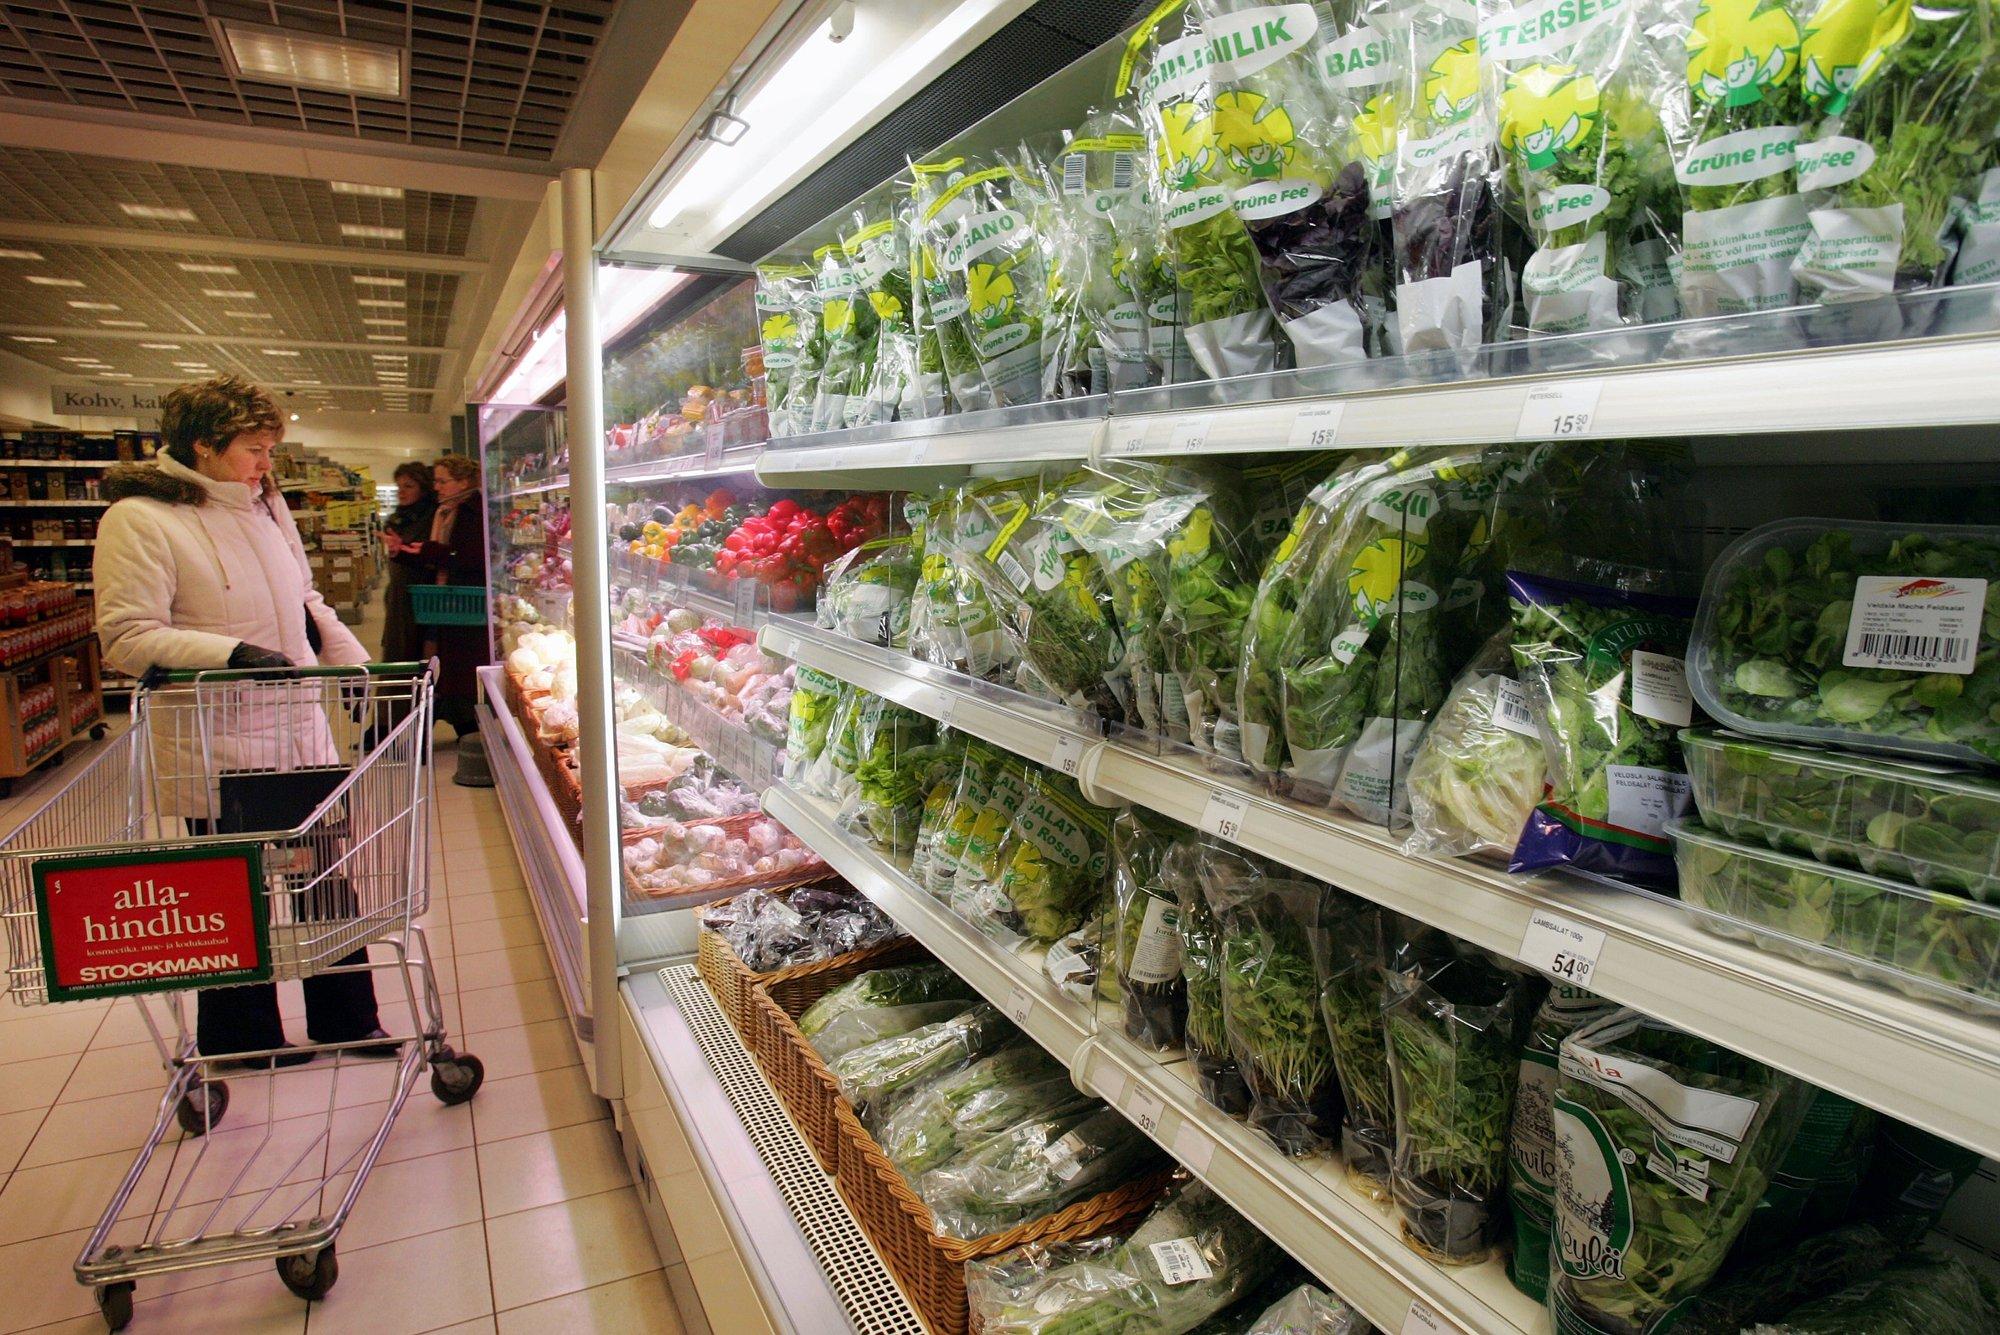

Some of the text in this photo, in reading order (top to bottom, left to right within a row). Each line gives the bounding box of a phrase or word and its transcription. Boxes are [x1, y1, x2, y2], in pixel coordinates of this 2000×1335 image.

[1686, 147, 1756, 174] Grüne
[1198, 192, 1225, 210] Fee
[1233, 185, 1309, 212] Grüne Fee
[1557, 192, 1593, 213] Fee
[64, 392, 125, 410] Kohv,
[1553, 415, 1574, 434] 15
[1311, 429, 1326, 445] 15
[1218, 818, 1231, 836] 15
[113, 879, 189, 910] alla-
[83, 908, 226, 943] hindlus
[1533, 917, 1569, 935] LAMBSALAT
[80, 954, 239, 982] STOCKMANN
[1552, 953, 1576, 978] 54
[1576, 961, 1590, 975] 00
[1139, 1114, 1151, 1130] 33
